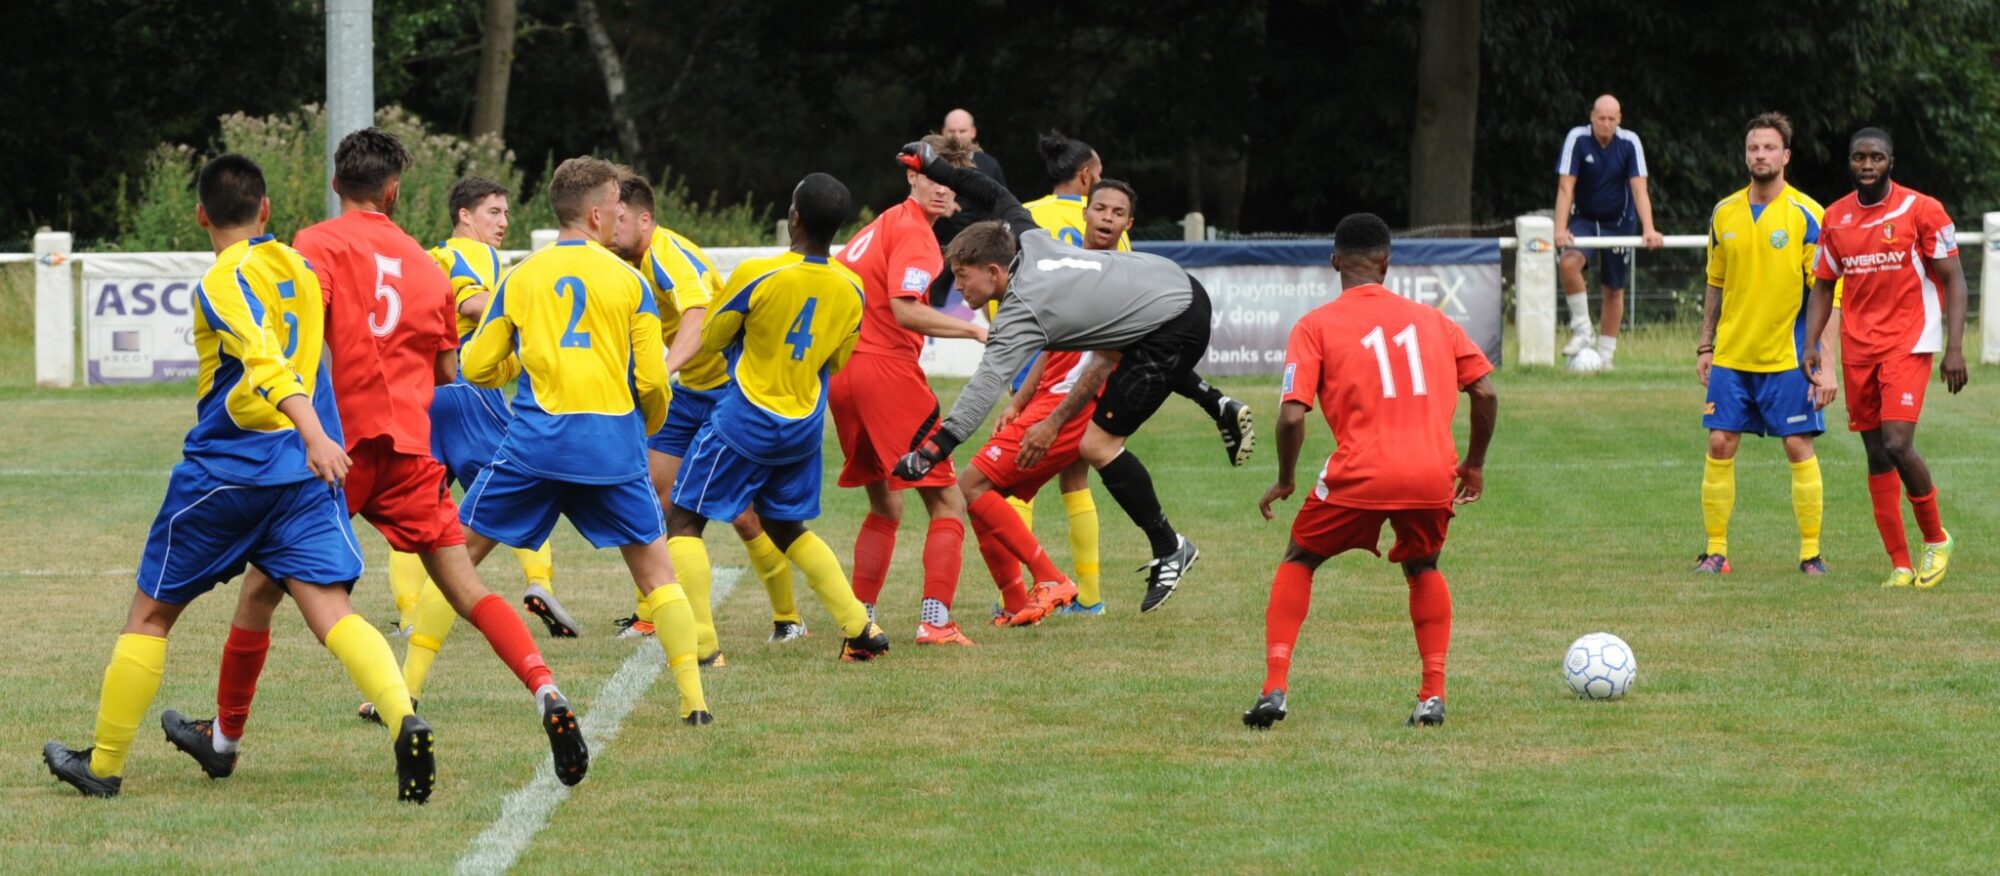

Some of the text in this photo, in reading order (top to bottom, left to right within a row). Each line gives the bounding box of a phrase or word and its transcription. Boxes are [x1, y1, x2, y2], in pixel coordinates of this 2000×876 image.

[95, 282, 195, 317] ASC
[368, 252, 402, 337] 5
[554, 276, 591, 349] 2
[1226, 281, 1327, 302] payments
[1229, 305, 1280, 324] done
[784, 296, 818, 361] 4
[1208, 345, 1260, 363] banks
[1360, 323, 1427, 398] 11
